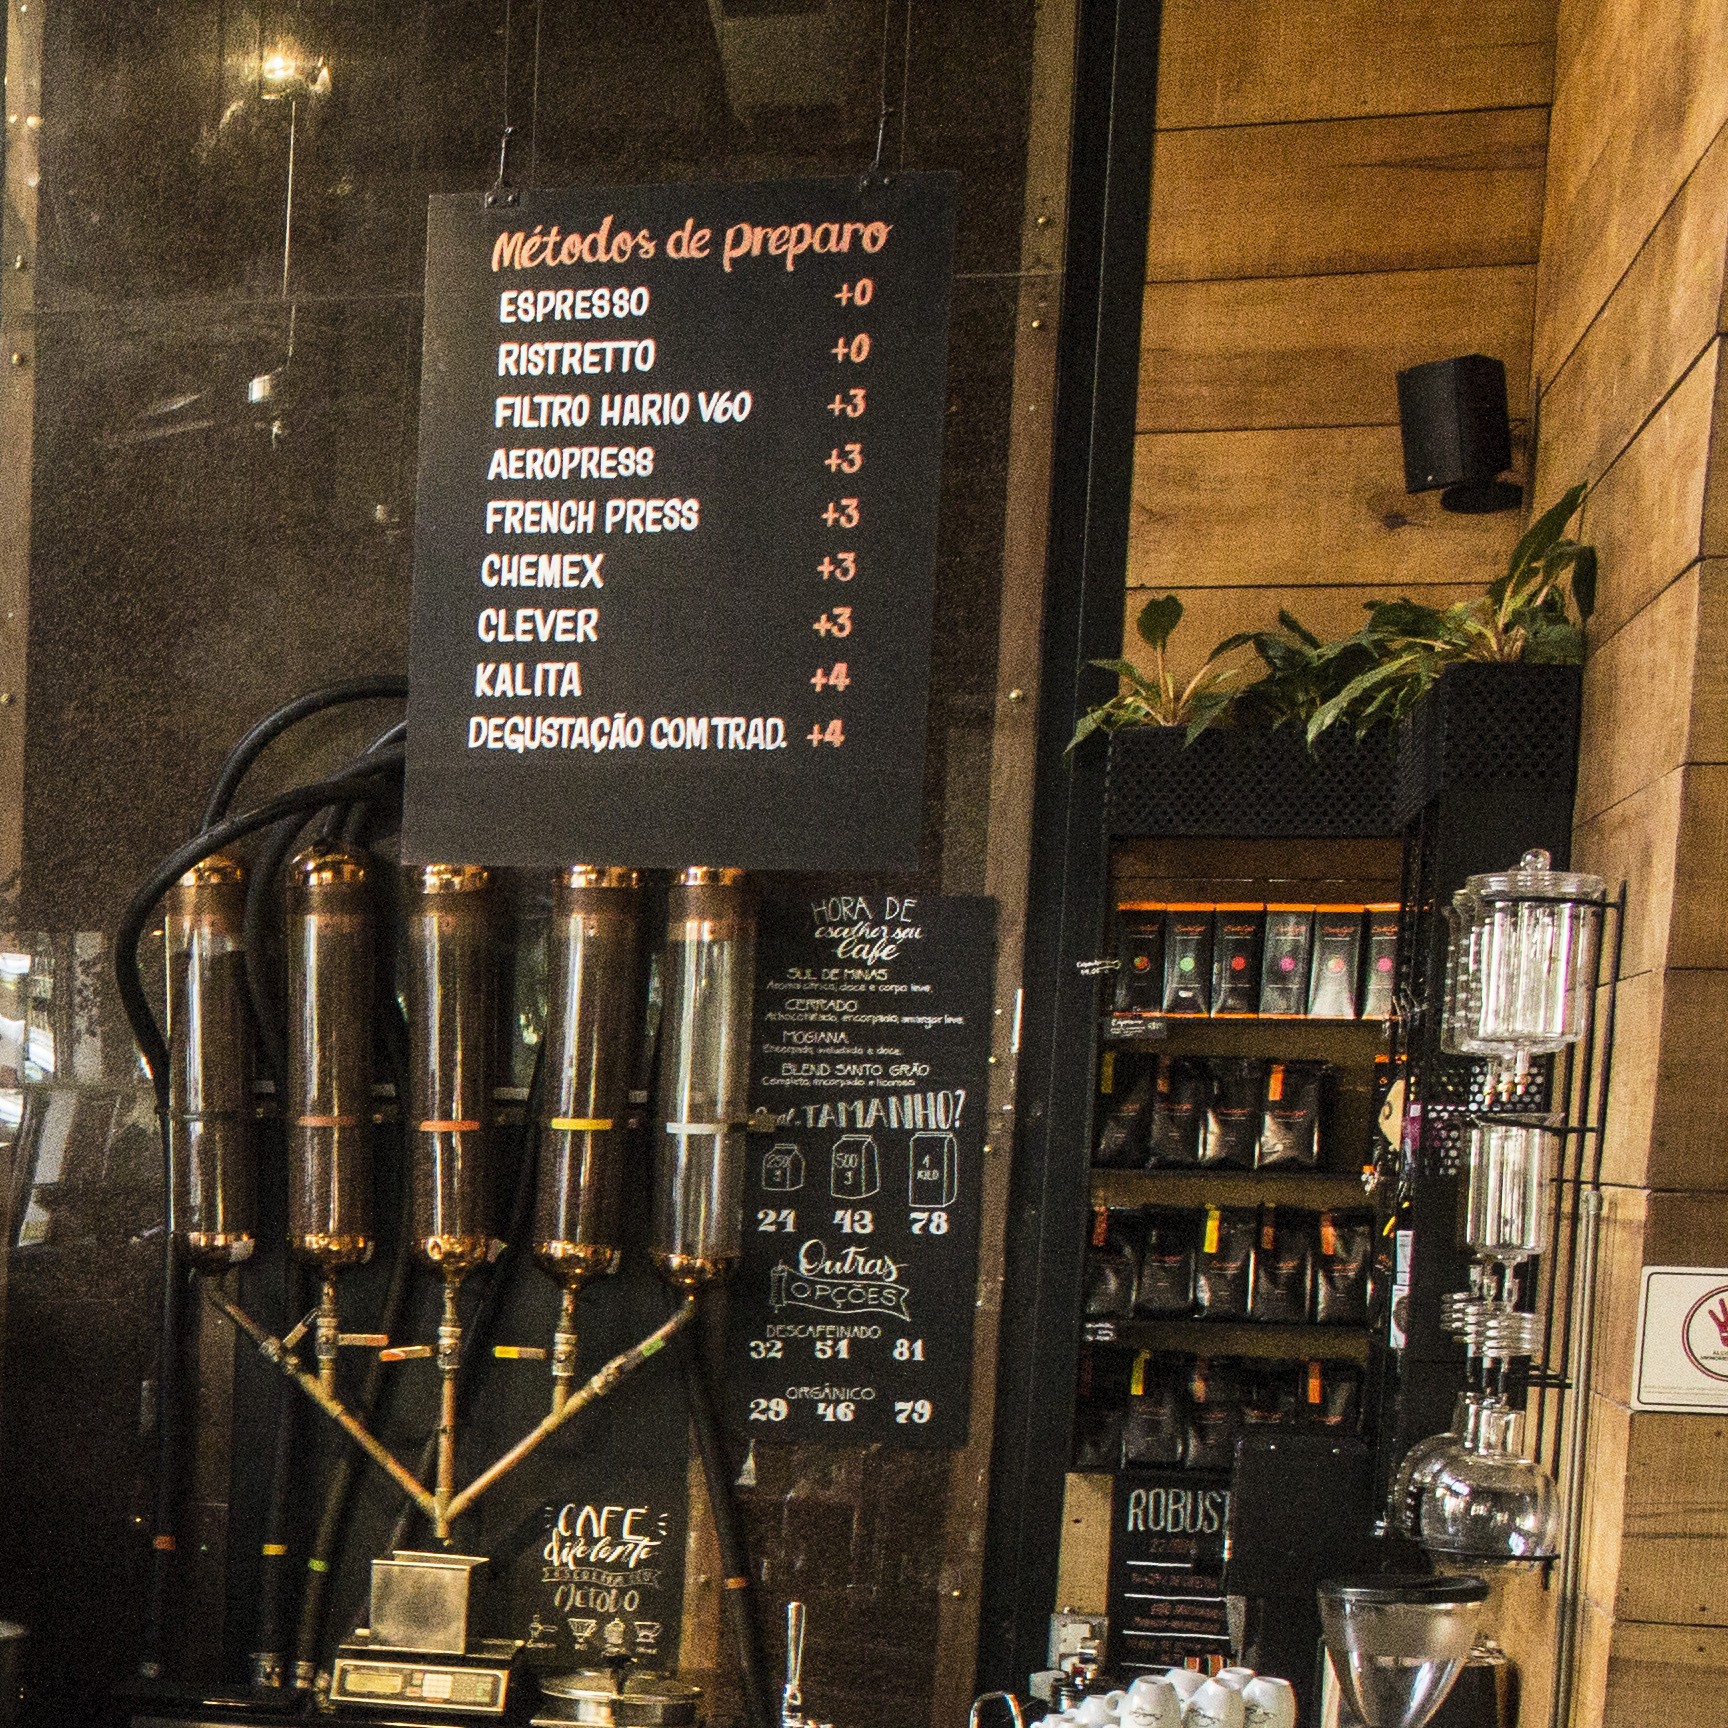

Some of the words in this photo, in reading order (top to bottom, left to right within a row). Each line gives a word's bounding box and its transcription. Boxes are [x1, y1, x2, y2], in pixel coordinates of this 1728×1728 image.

[491, 214, 656, 273] Métodos
[665, 217, 711, 261] de
[722, 220, 894, 273] preparo
[499, 286, 650, 324] ESPRESSO
[834, 276, 874, 309] +0
[497, 338, 656, 376] RISTRETTO
[830, 333, 871, 364] +0
[494, 394, 590, 429] FILTRO
[600, 393, 690, 427] HARIO
[698, 390, 753, 424] V60
[827, 389, 867, 420] +3
[486, 446, 655, 482] AEROPRESS
[823, 442, 863, 474] +3
[484, 498, 596, 536] FRENCH
[604, 498, 701, 534] PRESS
[820, 498, 861, 530] +3
[480, 553, 605, 590] CHEMEX
[816, 551, 857, 582] +3
[477, 607, 599, 643] CLEVER
[812, 605, 853, 639] +3
[475, 661, 583, 700] KALITA
[809, 662, 852, 693] +4
[467, 712, 644, 755] DEGUSTAÇÃO
[650, 717, 709, 750] COM
[710, 717, 789, 751] TRAD.
[806, 719, 846, 749] +4
[811, 896, 874, 925] HORA
[884, 896, 918, 923] DE
[814, 921, 887, 939] escolher
[892, 924, 923, 940] seu
[786, 967, 817, 981] SUL
[820, 967, 841, 981] DE
[843, 967, 889, 981] MINAS
[784, 998, 858, 1012] CERRADO
[782, 1030, 850, 1044] MOGIANA
[781, 1062, 832, 1077] BLEND
[834, 1063, 883, 1077] SANTO
[888, 1062, 930, 1077] GRÃO
[757, 1209, 797, 1233] 24
[833, 1209, 875, 1234] 43
[909, 1211, 949, 1235] 78
[798, 1239, 908, 1282] Outras
[790, 1282, 897, 1309] OPÇÕES
[766, 1325, 882, 1339] DESCAFEINADO
[749, 1340, 784, 1359] 32
[815, 1339, 851, 1360] 51
[893, 1338, 925, 1361] 81
[749, 1398, 790, 1422] 29
[816, 1401, 856, 1422] 46
[894, 1399, 933, 1424] 79
